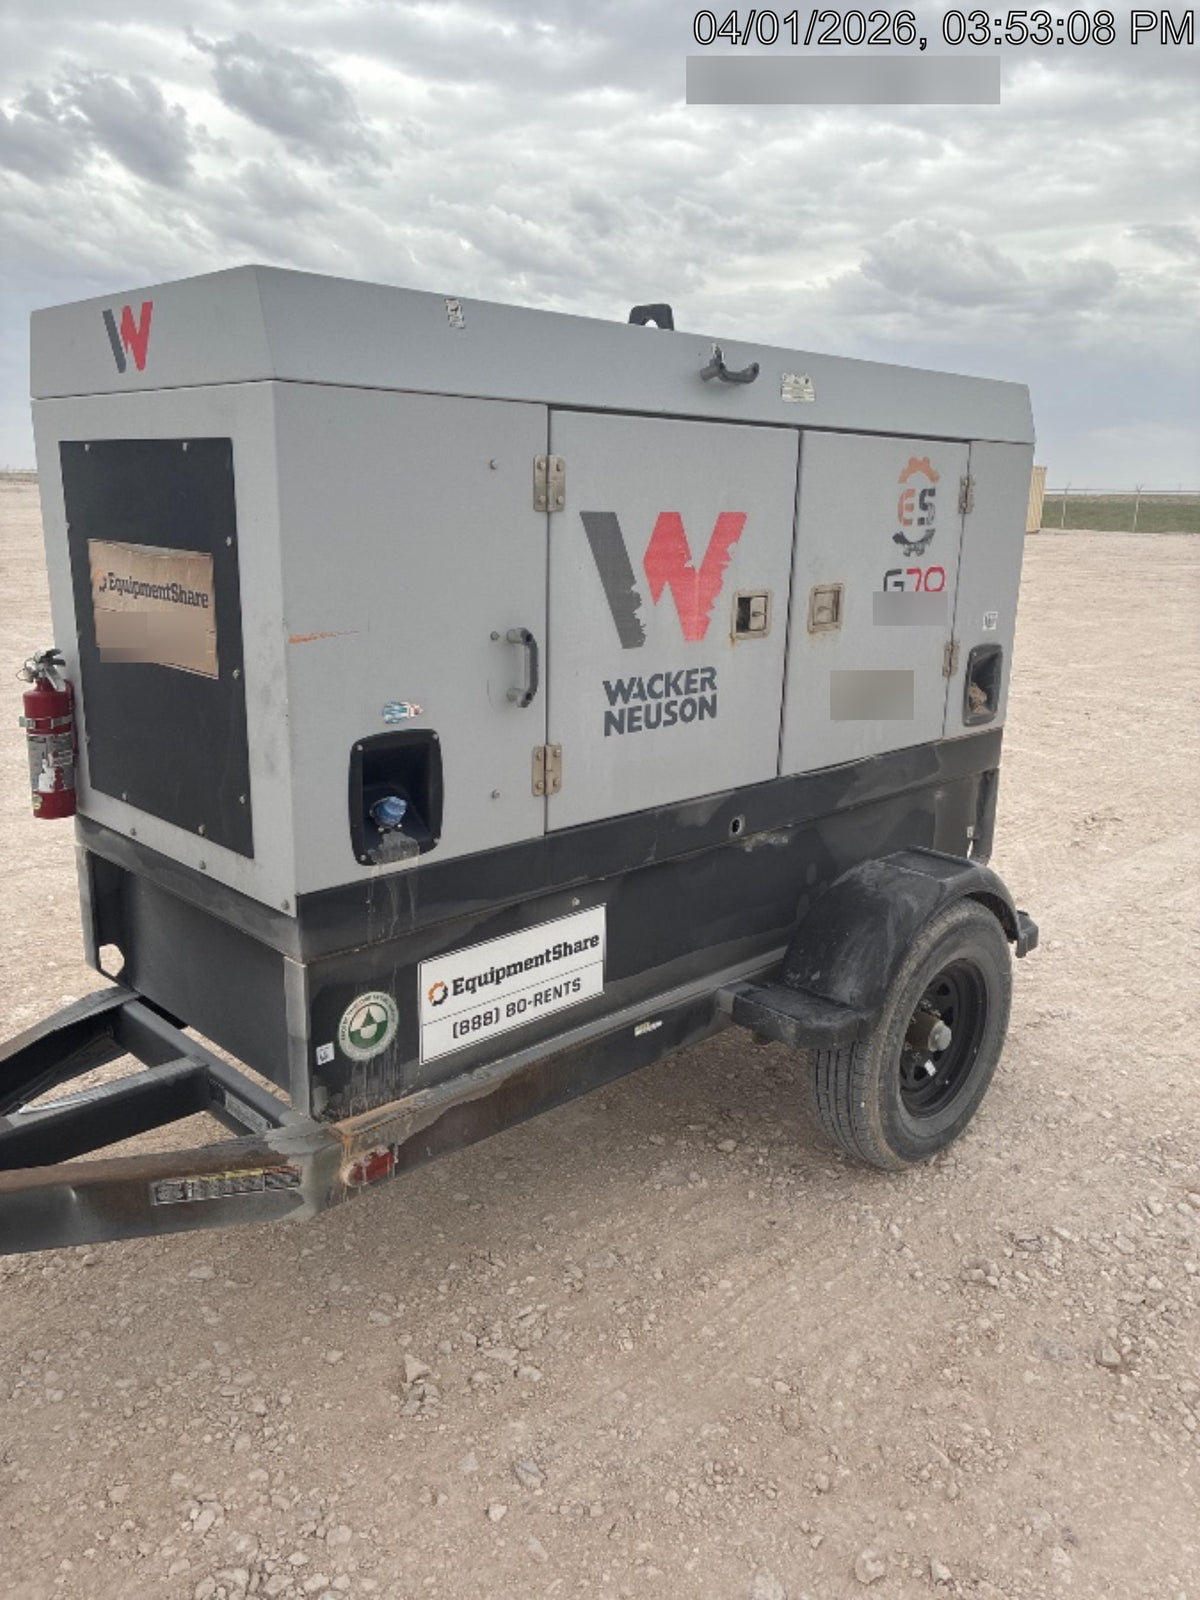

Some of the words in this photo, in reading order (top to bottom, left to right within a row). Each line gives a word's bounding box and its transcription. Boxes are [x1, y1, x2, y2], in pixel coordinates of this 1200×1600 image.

[898, 488, 936, 526] ES
[108, 572, 208, 608] EquipmentShare
[883, 566, 945, 592] G70
[602, 666, 717, 706] WACKER
[604, 694, 717, 737] NEUSON
[452, 935, 600, 996] EquipmentShare
[452, 1008, 500, 1038] (888)
